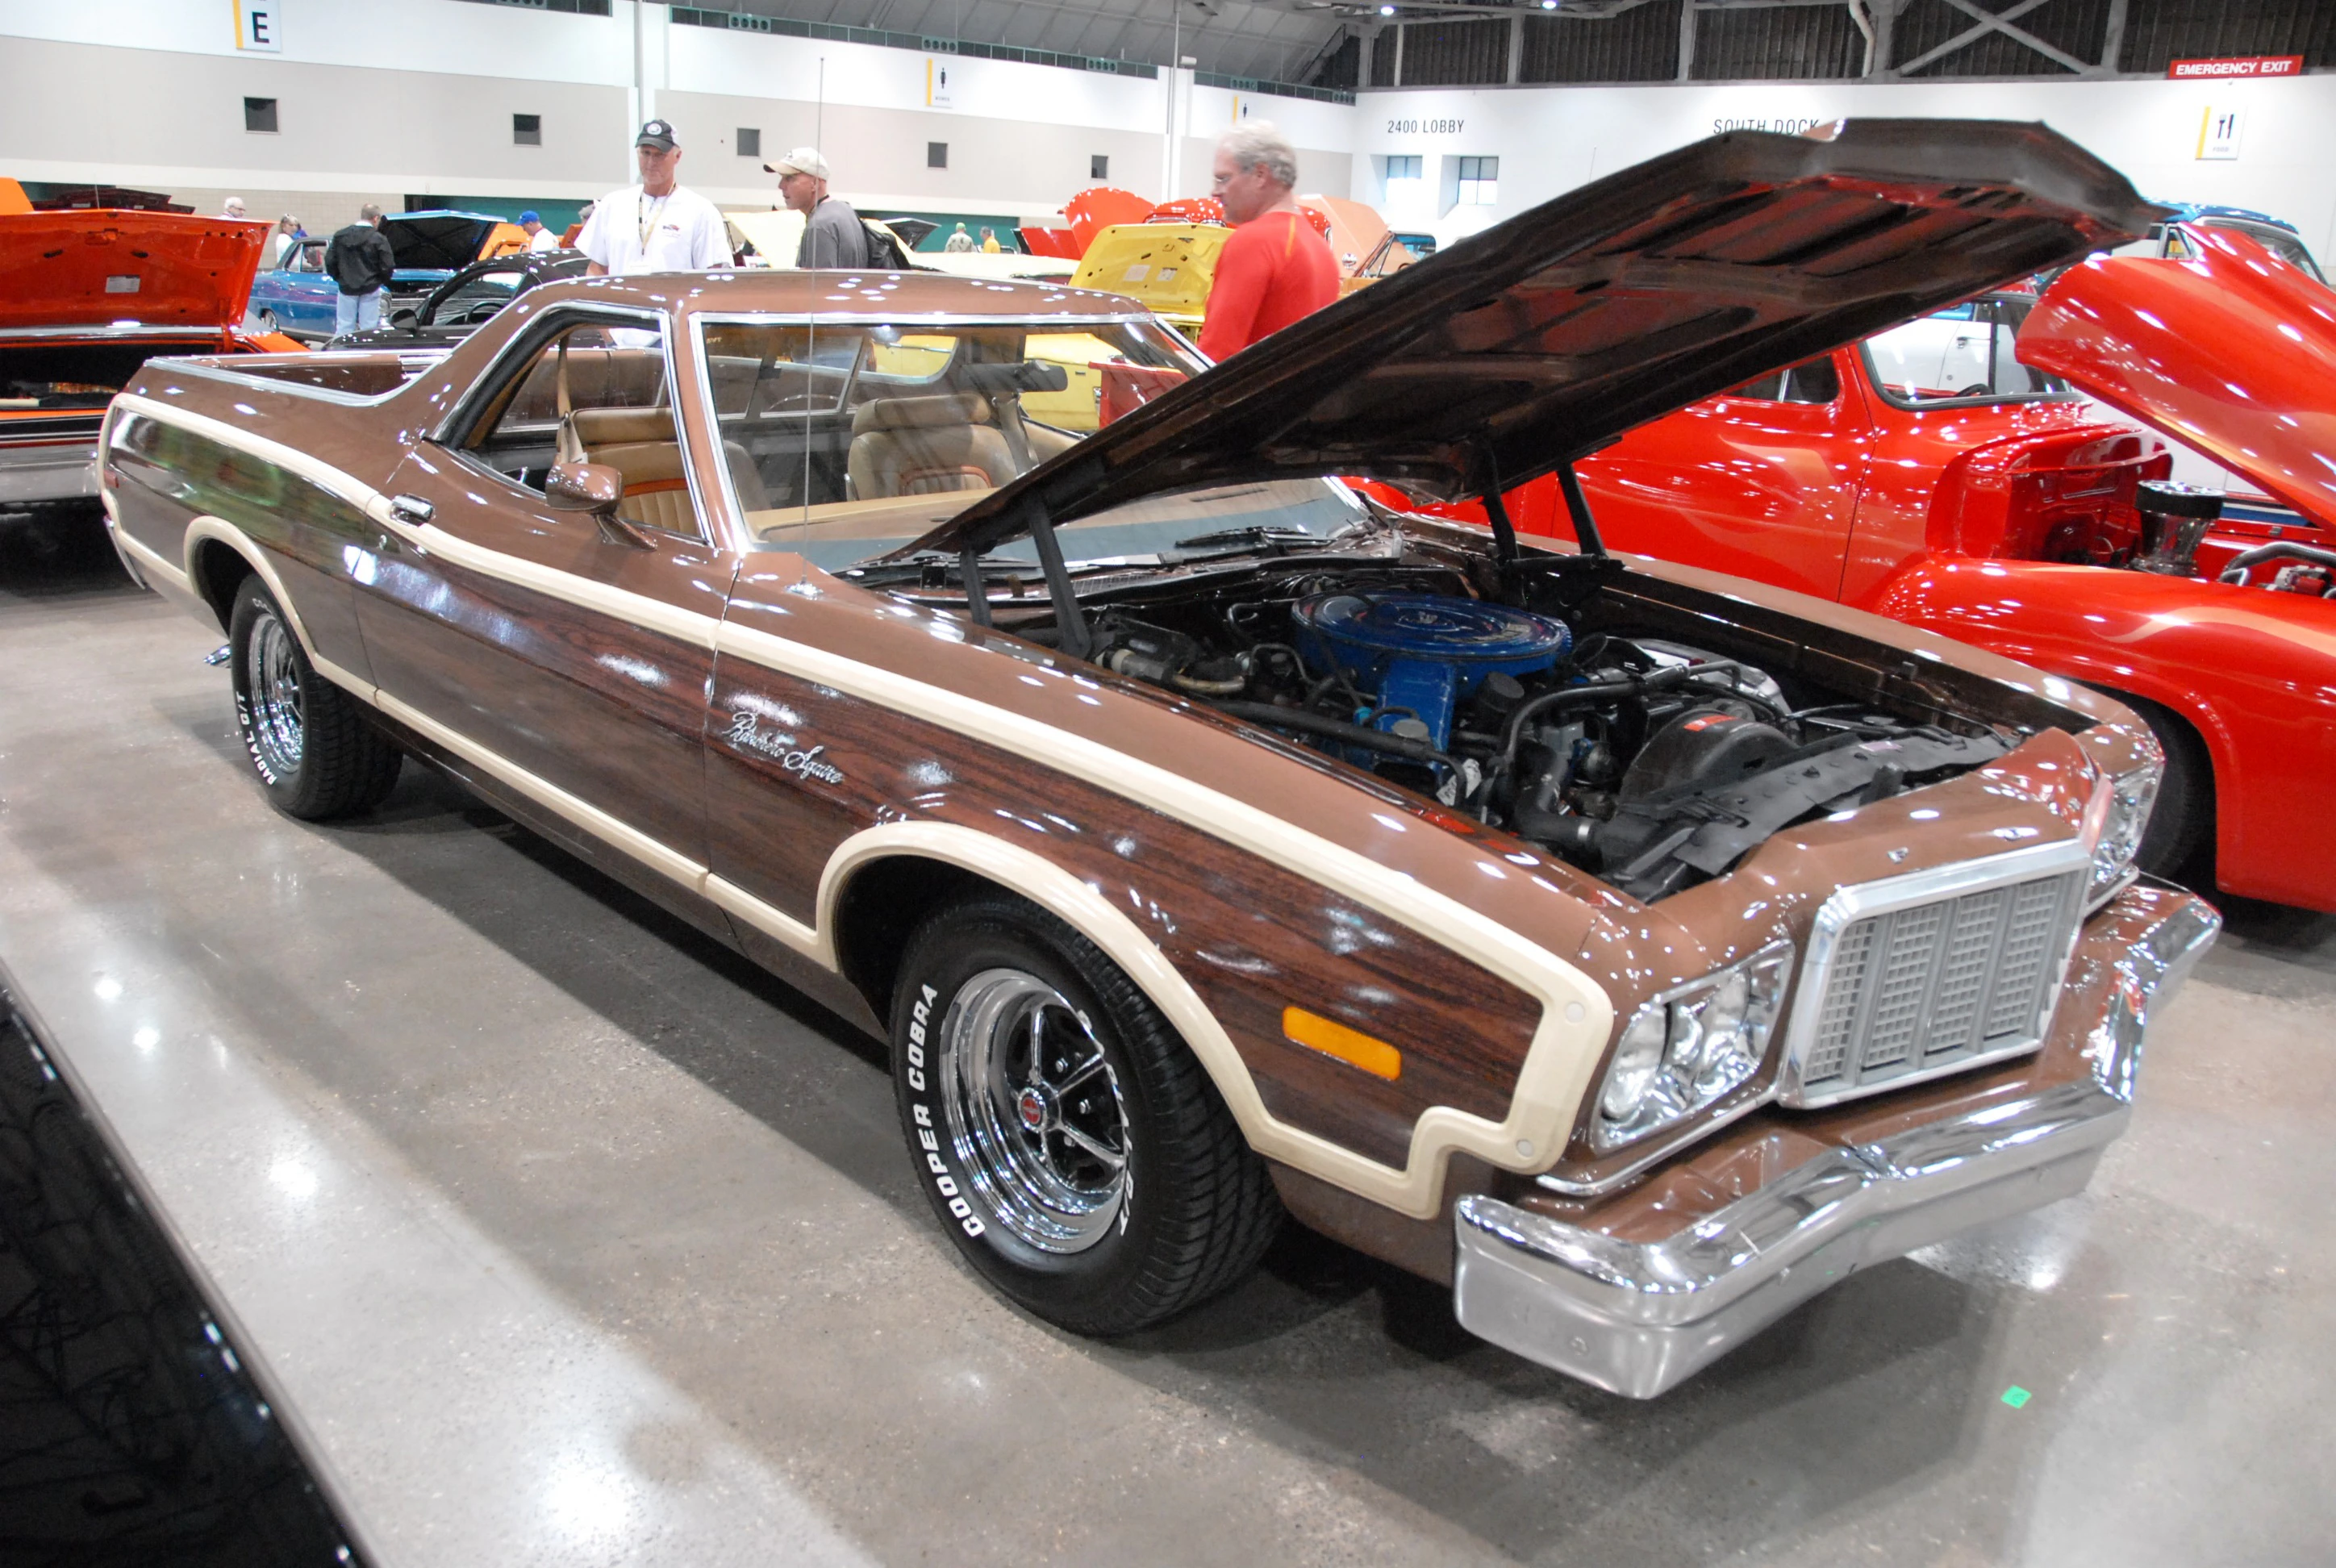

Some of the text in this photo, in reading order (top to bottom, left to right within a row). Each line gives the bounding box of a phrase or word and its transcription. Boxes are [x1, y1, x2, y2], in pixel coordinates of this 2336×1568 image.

[252, 11, 269, 44] E
[2175, 60, 2292, 75] EMERGENCY EXIT
[1387, 119, 1464, 133] 2400 LOBBY
[1713, 119, 1819, 135] SOUTH DOCK
[722, 711, 785, 757] Ranchero
[246, 731, 277, 785] RADIAL
[908, 983, 986, 1237] COOPER COBRA
